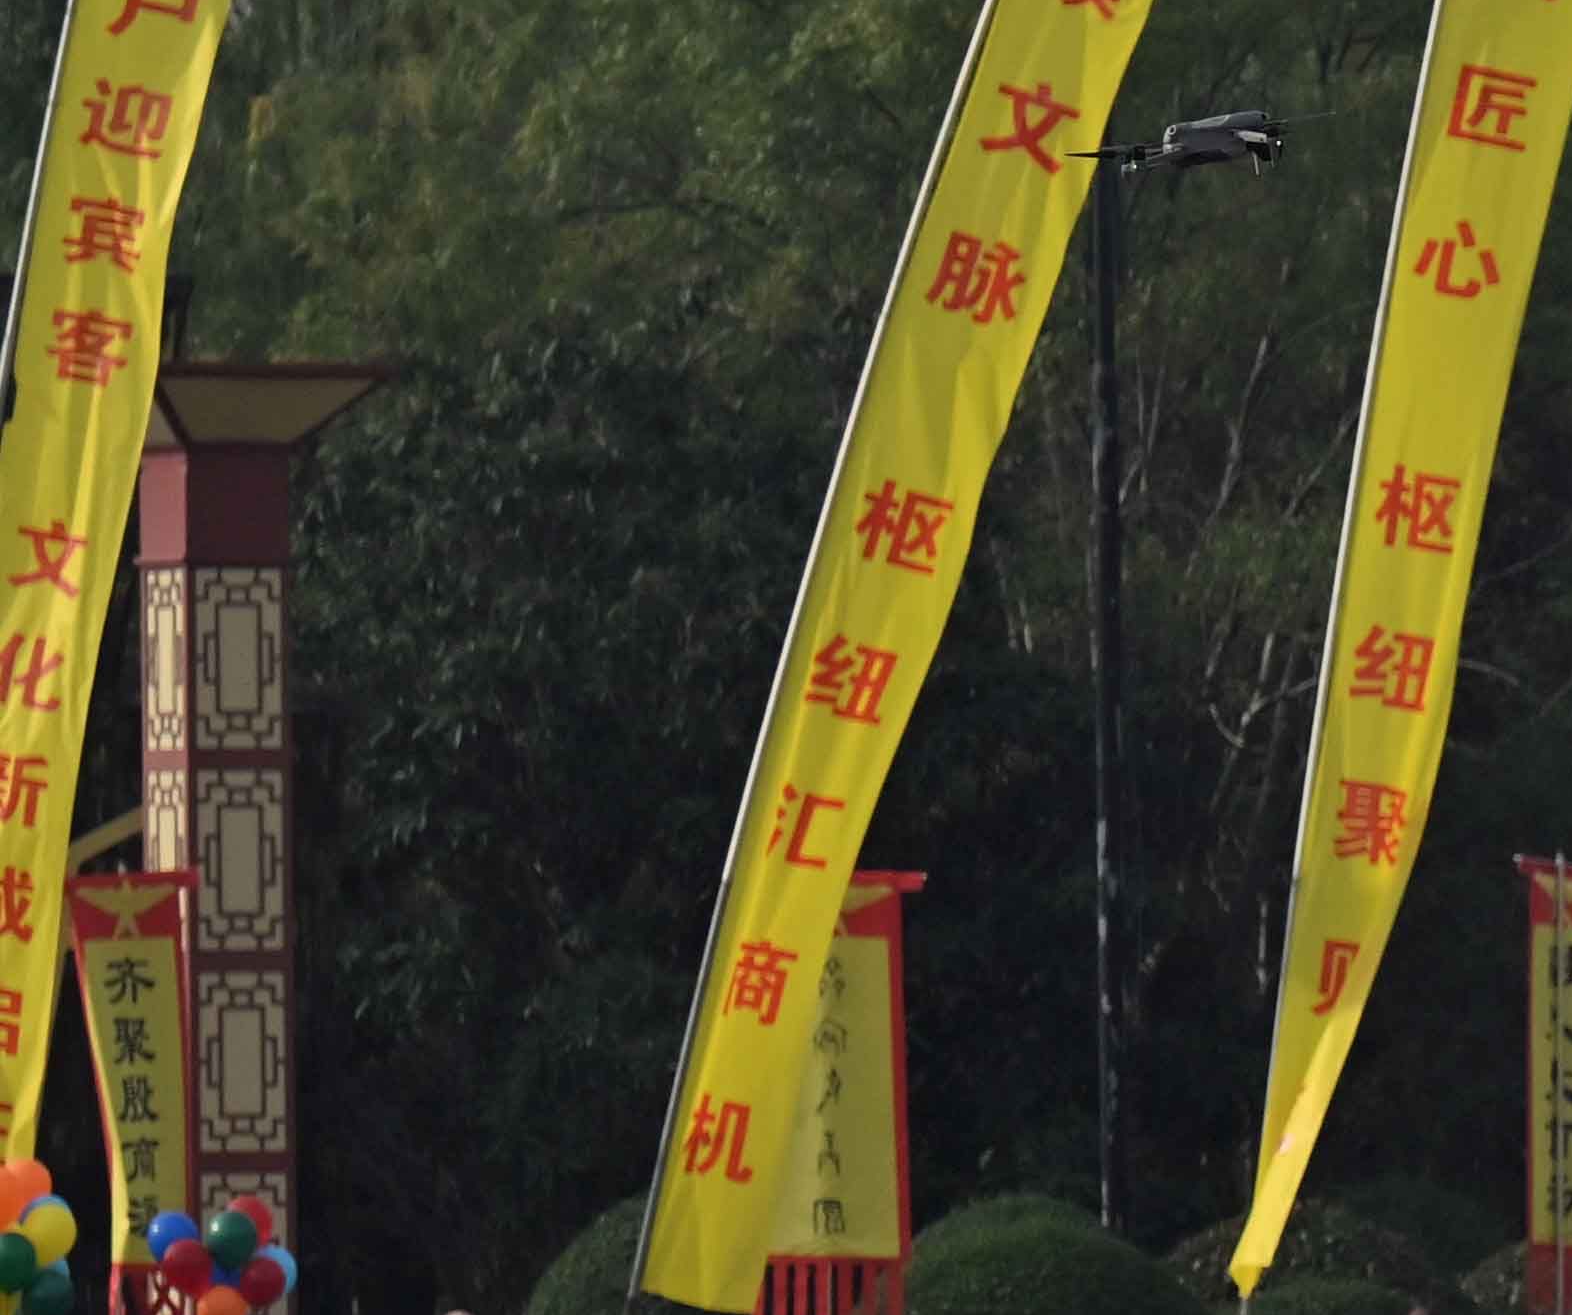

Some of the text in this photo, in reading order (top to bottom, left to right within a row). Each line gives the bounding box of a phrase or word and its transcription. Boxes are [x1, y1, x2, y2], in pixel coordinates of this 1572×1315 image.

[685, 481, 954, 1185] 枢纽汇商机
